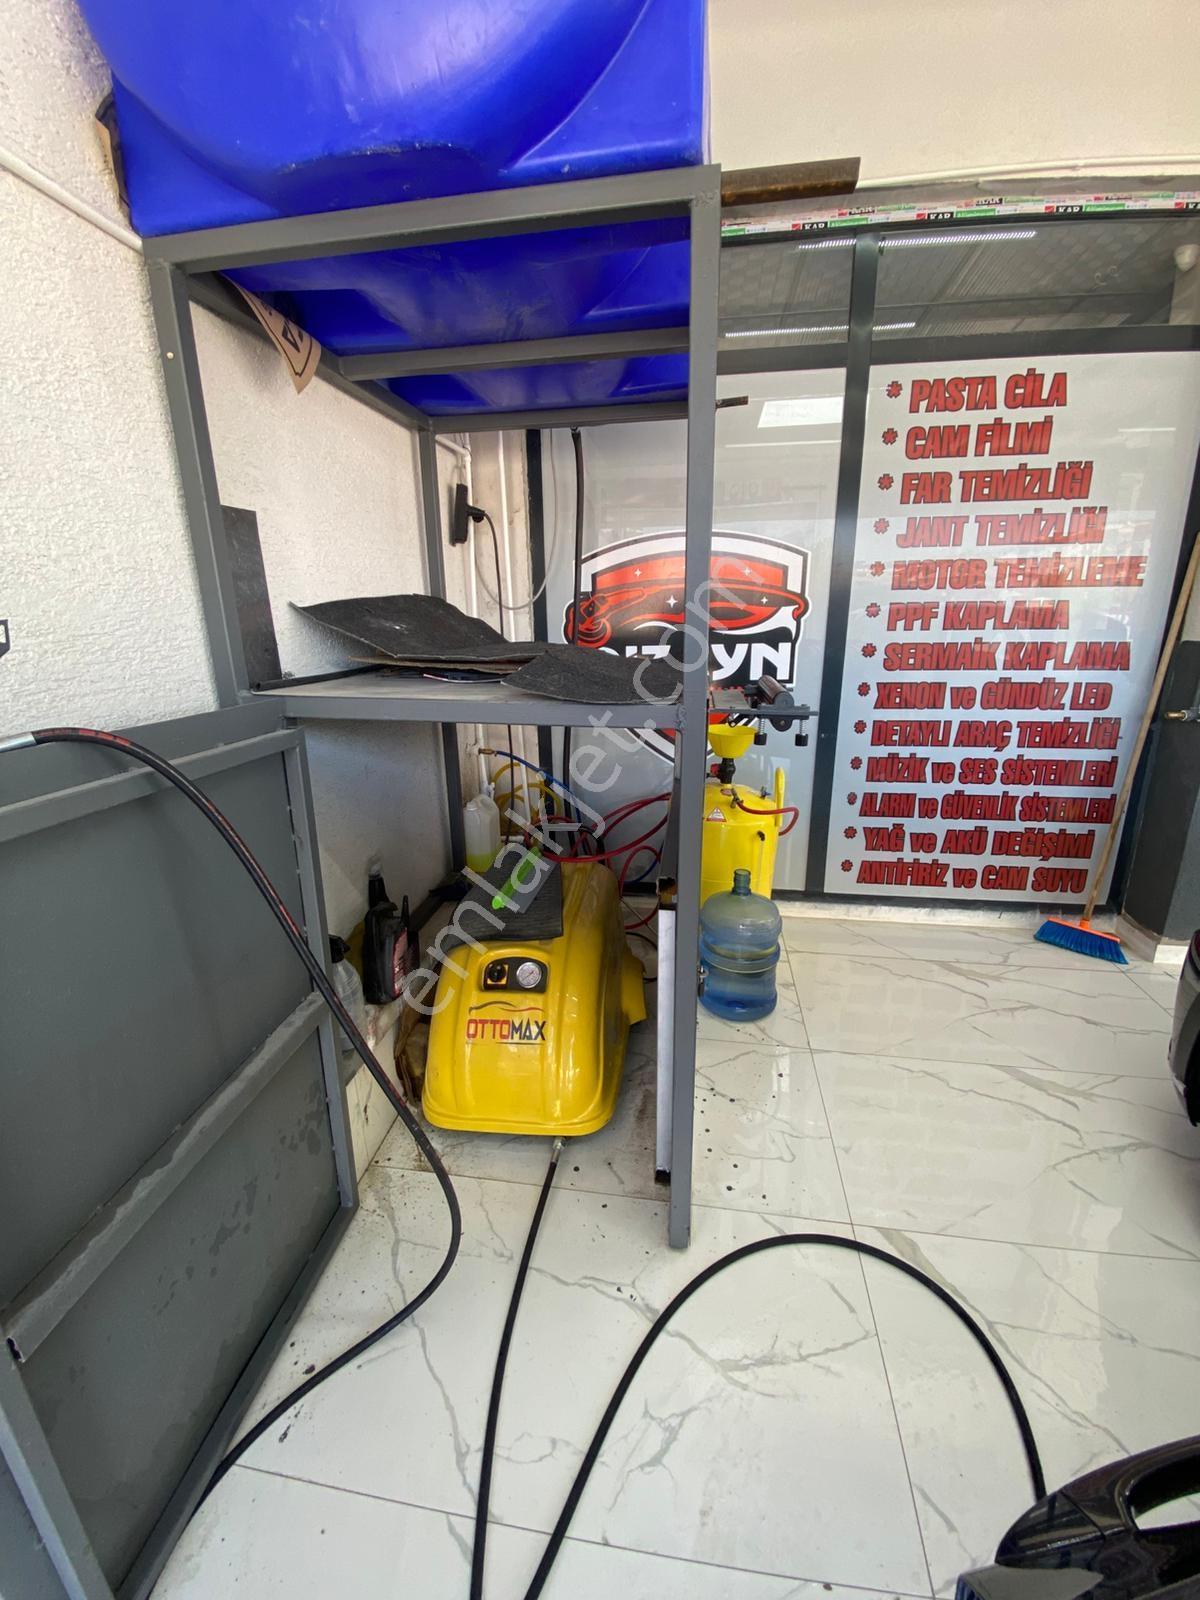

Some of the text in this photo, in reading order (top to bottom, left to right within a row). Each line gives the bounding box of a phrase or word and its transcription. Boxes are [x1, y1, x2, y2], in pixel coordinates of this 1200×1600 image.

[909, 376, 997, 413] PASTA
[905, 415, 1053, 460] CAM FİLMİ
[900, 461, 1094, 504] FAR TEMİZLİĞİ
[896, 506, 1108, 548] JANT TEMİZLİĞİ
[891, 559, 987, 591] MOTOR
[887, 600, 1069, 631] PPF KAPLAMA
[1002, 641, 1131, 671] KAPLAMA
[874, 677, 1113, 711] XENON ve GÜNDÜZ LED
[870, 717, 1122, 752] DETAYLI ARAÇ TEMİZLİĞİ
[866, 753, 1118, 788] MÜZİK ve SES SİSTEMLERİ
[859, 791, 1118, 824] ALARM ve GÜVENLİK SİSTEMLERİ
[863, 823, 1096, 861] YAĞ ve AKÜ DEĞİŞİMİ
[856, 858, 1088, 894] ANTİFİRİZ ve CAM SUYU
[466, 1017, 546, 1041] OTTOMAX
